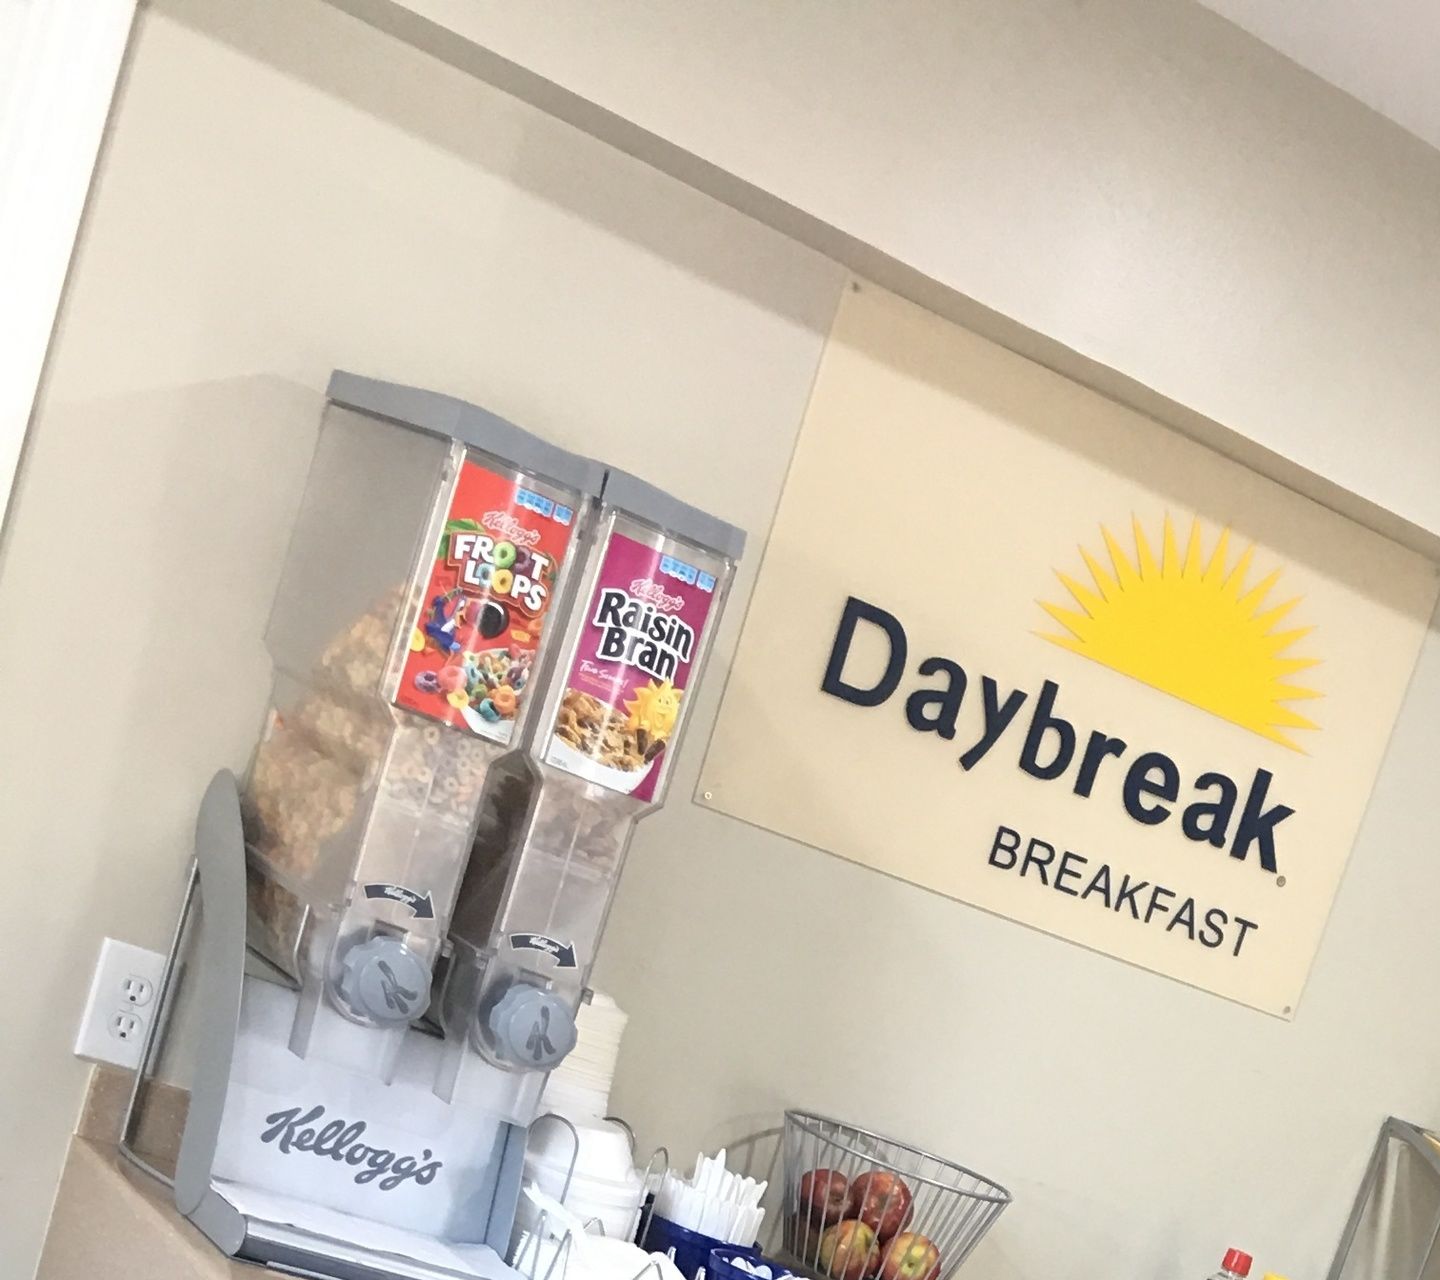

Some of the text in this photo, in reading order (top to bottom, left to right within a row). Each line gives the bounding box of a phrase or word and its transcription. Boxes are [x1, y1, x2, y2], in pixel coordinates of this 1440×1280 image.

[454, 534, 549, 581] FROOT
[464, 560, 546, 613] LOOPS
[597, 591, 693, 658] Raisin
[600, 627, 676, 679] Bran
[820, 596, 1296, 874] Daybreak
[988, 826, 1259, 957] BREAKFAST
[261, 1105, 442, 1191] Kellogg's
